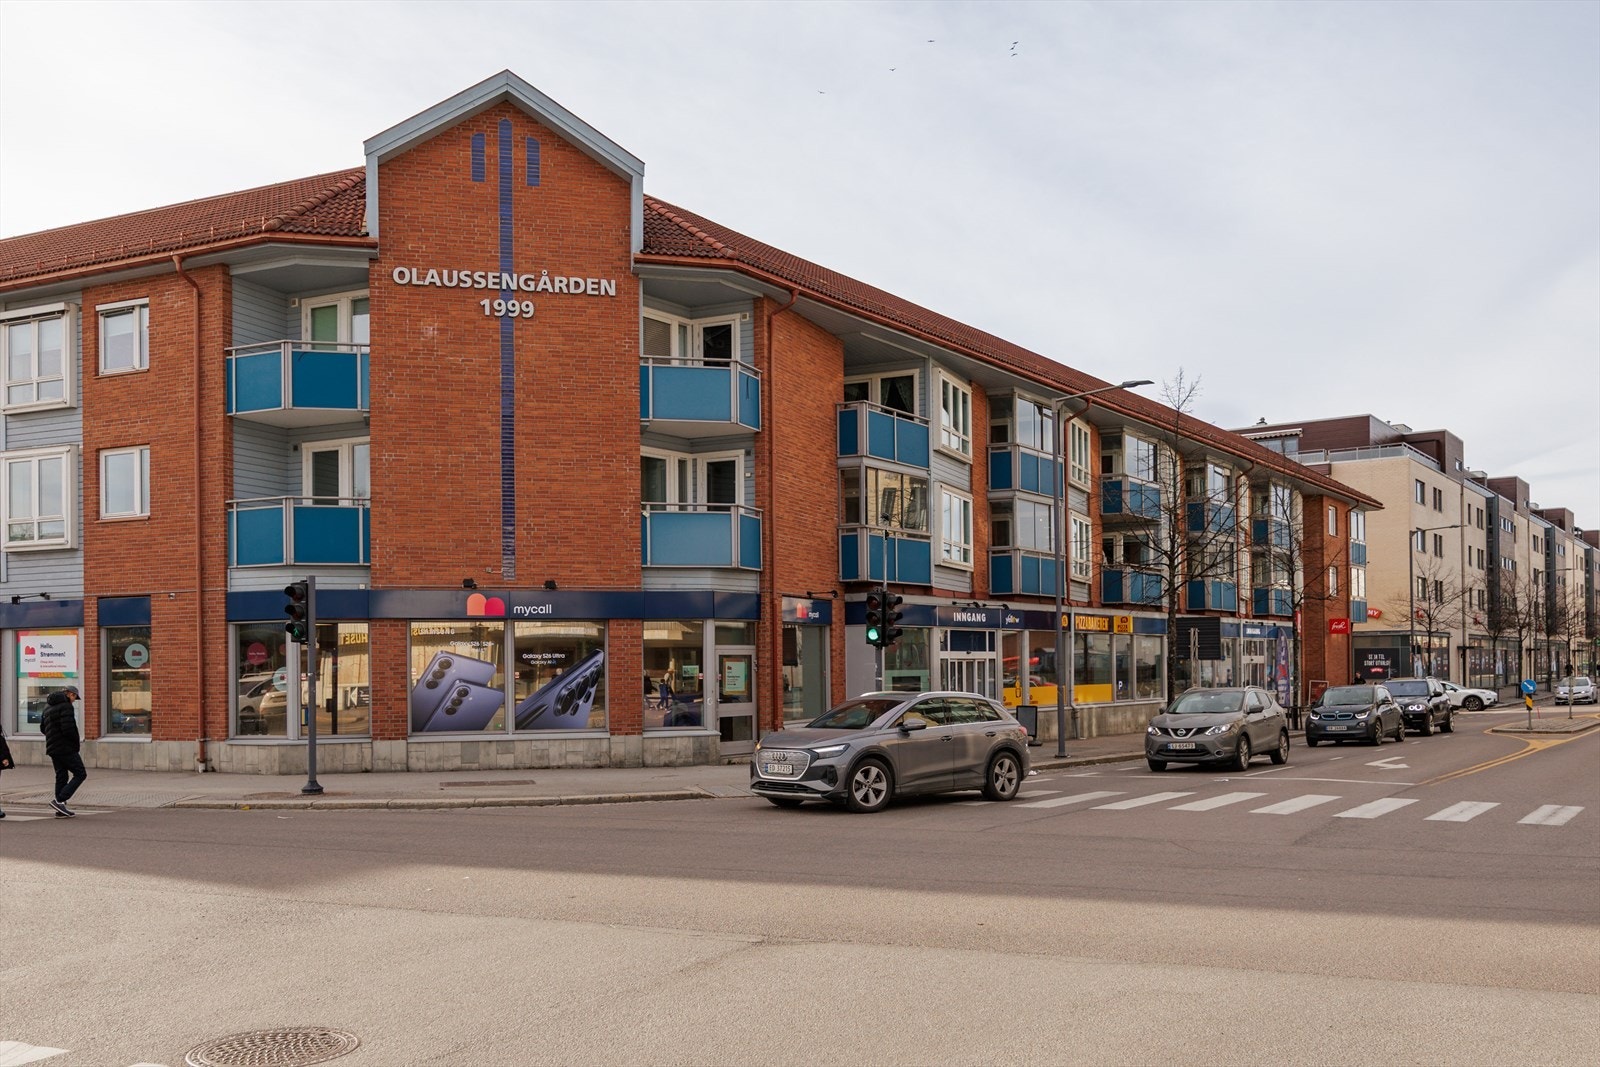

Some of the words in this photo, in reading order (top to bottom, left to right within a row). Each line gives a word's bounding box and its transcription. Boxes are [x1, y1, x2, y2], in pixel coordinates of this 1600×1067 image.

[392, 266, 616, 297] OLAUSSENGÅRDEN
[480, 298, 535, 318] 1999
[513, 604, 552, 617] mycall
[953, 612, 987, 622] INNGANG
[1118, 680, 1123, 690] P
